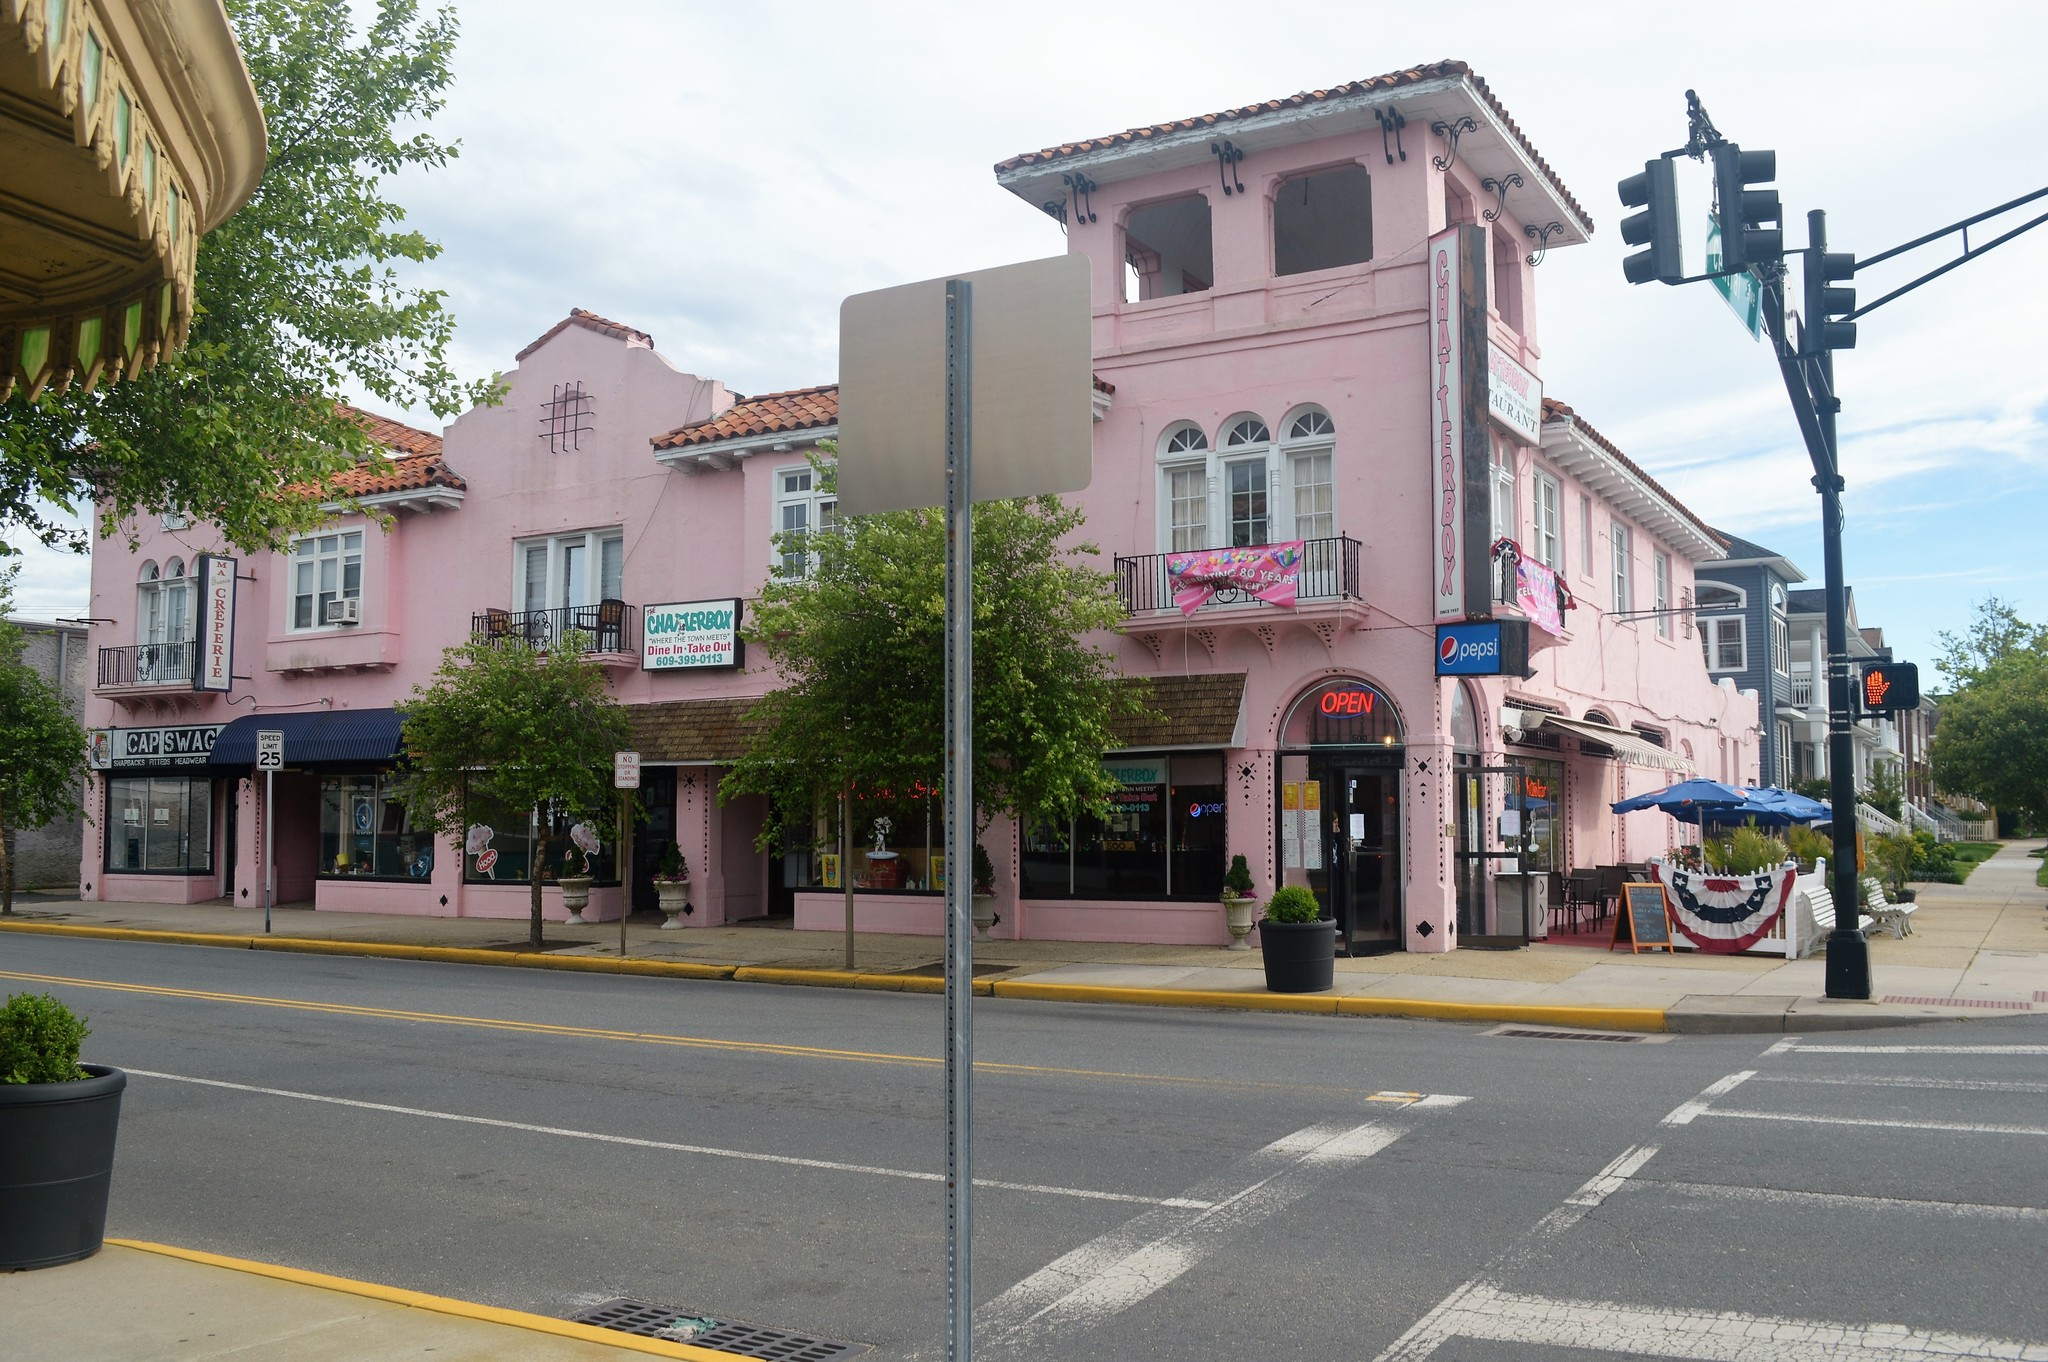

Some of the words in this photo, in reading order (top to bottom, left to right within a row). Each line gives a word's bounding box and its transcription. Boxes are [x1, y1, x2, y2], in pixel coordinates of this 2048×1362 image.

[1436, 249, 1455, 596] CHATTERBOX
[1239, 567, 1256, 579] 80
[1260, 569, 1295, 585] YEARS
[647, 610, 733, 635] CHATTERBOX
[687, 634, 705, 642] TOWN
[648, 645, 670, 656] Dine
[687, 643, 711, 653] Take
[713, 641, 731, 651] Out
[1460, 637, 1498, 662] pepsi
[656, 653, 723, 667] 609-399-0113
[1321, 691, 1374, 713] OPEN
[127, 732, 160, 753] CAP
[164, 729, 216, 752] SWAG
[260, 752, 281, 766] 25
[1106, 842, 1126, 850] 500
[478, 851, 496, 870] Hood
